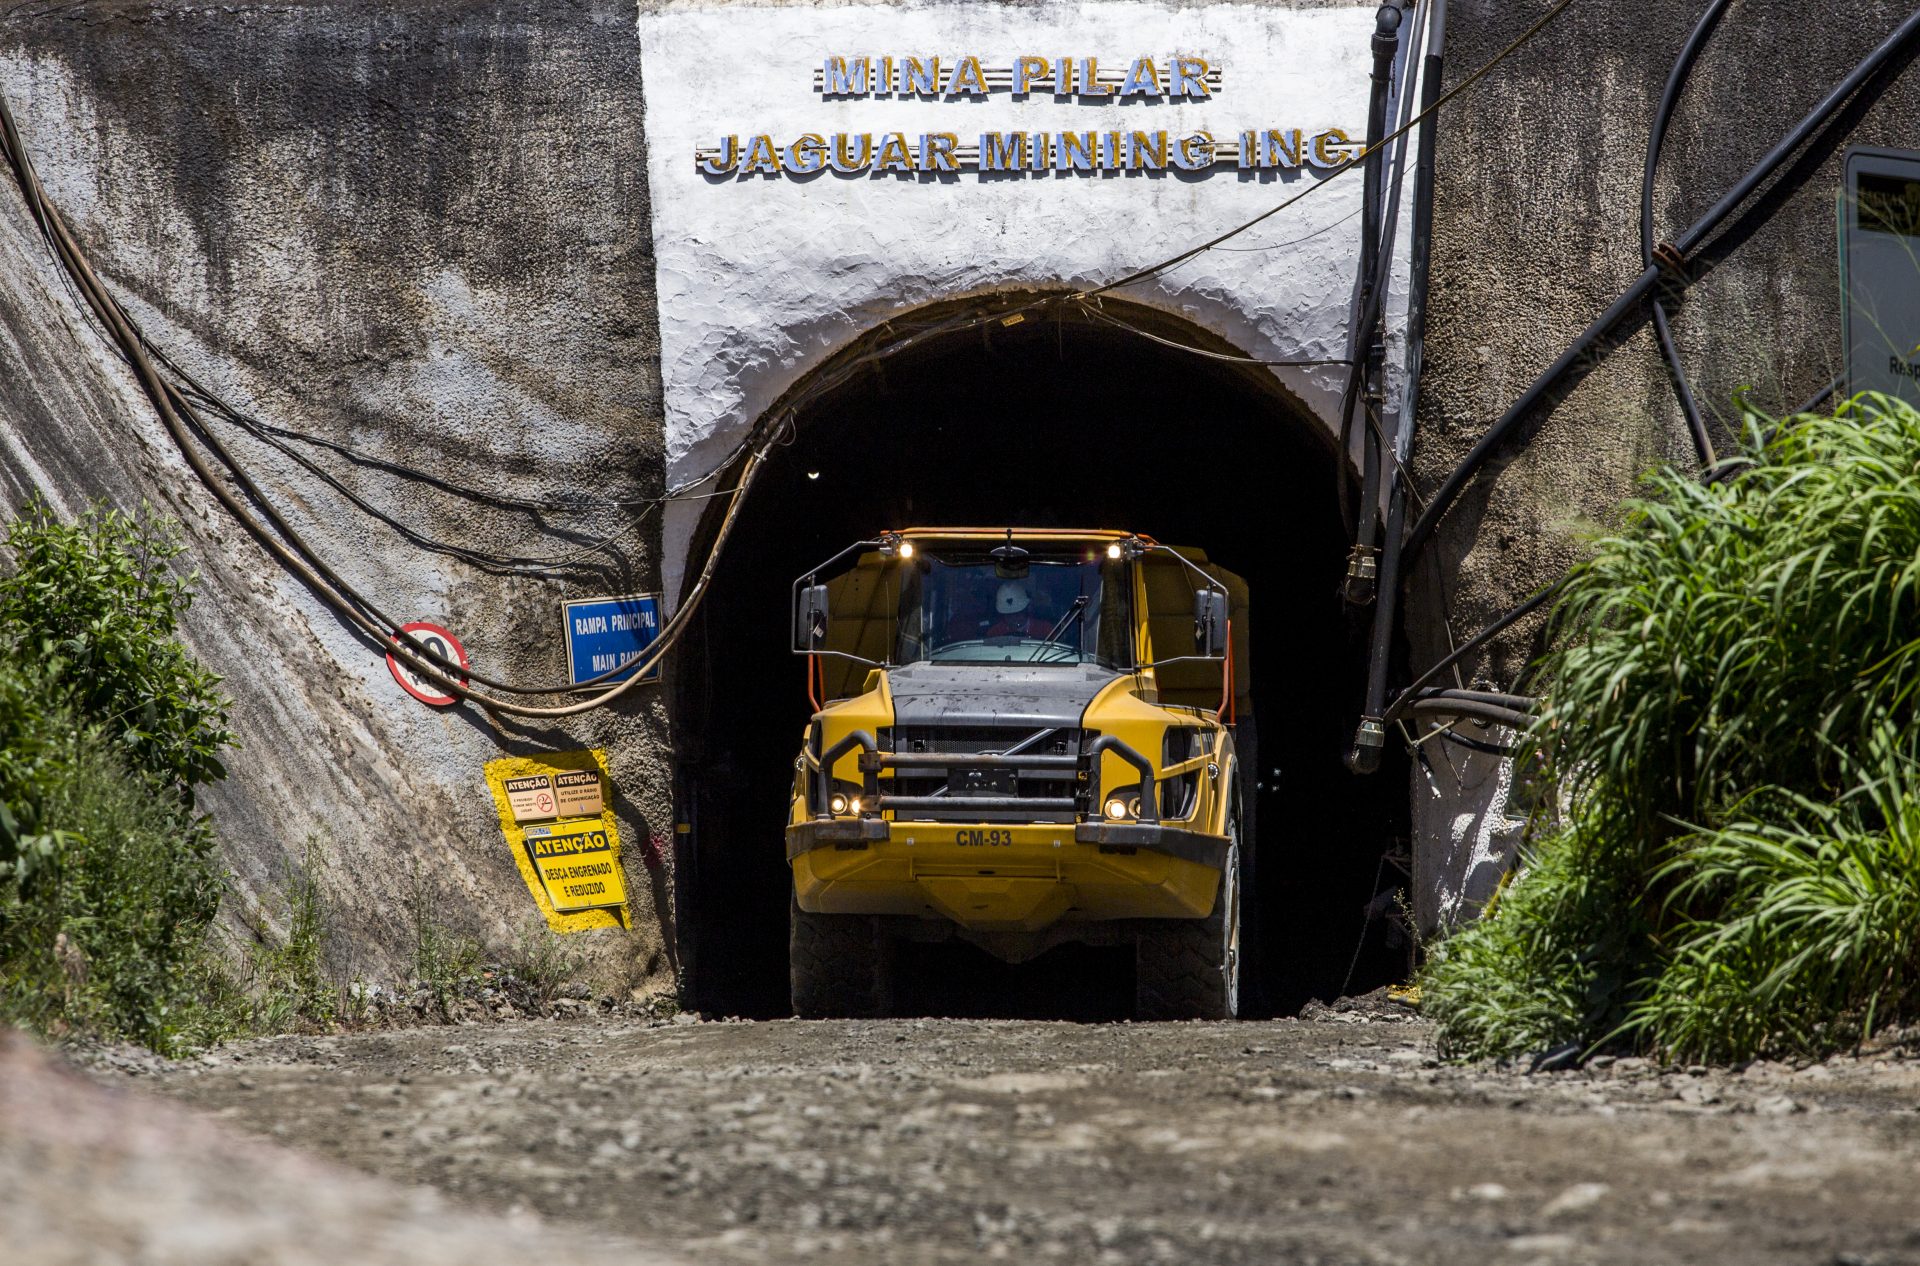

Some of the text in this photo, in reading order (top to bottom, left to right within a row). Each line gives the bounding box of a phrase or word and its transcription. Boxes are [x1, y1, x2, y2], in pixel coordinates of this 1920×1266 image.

[822, 55, 1213, 97] MINA PILAR
[703, 131, 961, 174] JAGUAR
[980, 128, 1215, 173] MINING
[575, 610, 656, 636] RAMPA PRINCIPAL
[592, 653, 616, 673] MAIN
[508, 778, 548, 790] ATENÇÃO
[557, 772, 597, 785] ATENÇÃO
[568, 794, 599, 802] COMUNICAÇÃO
[535, 832, 605, 855] ATENÇÃO
[956, 830, 1012, 847] CM-93
[567, 862, 613, 879] ENGRENADO
[563, 881, 606, 897] E REDUZIDO
